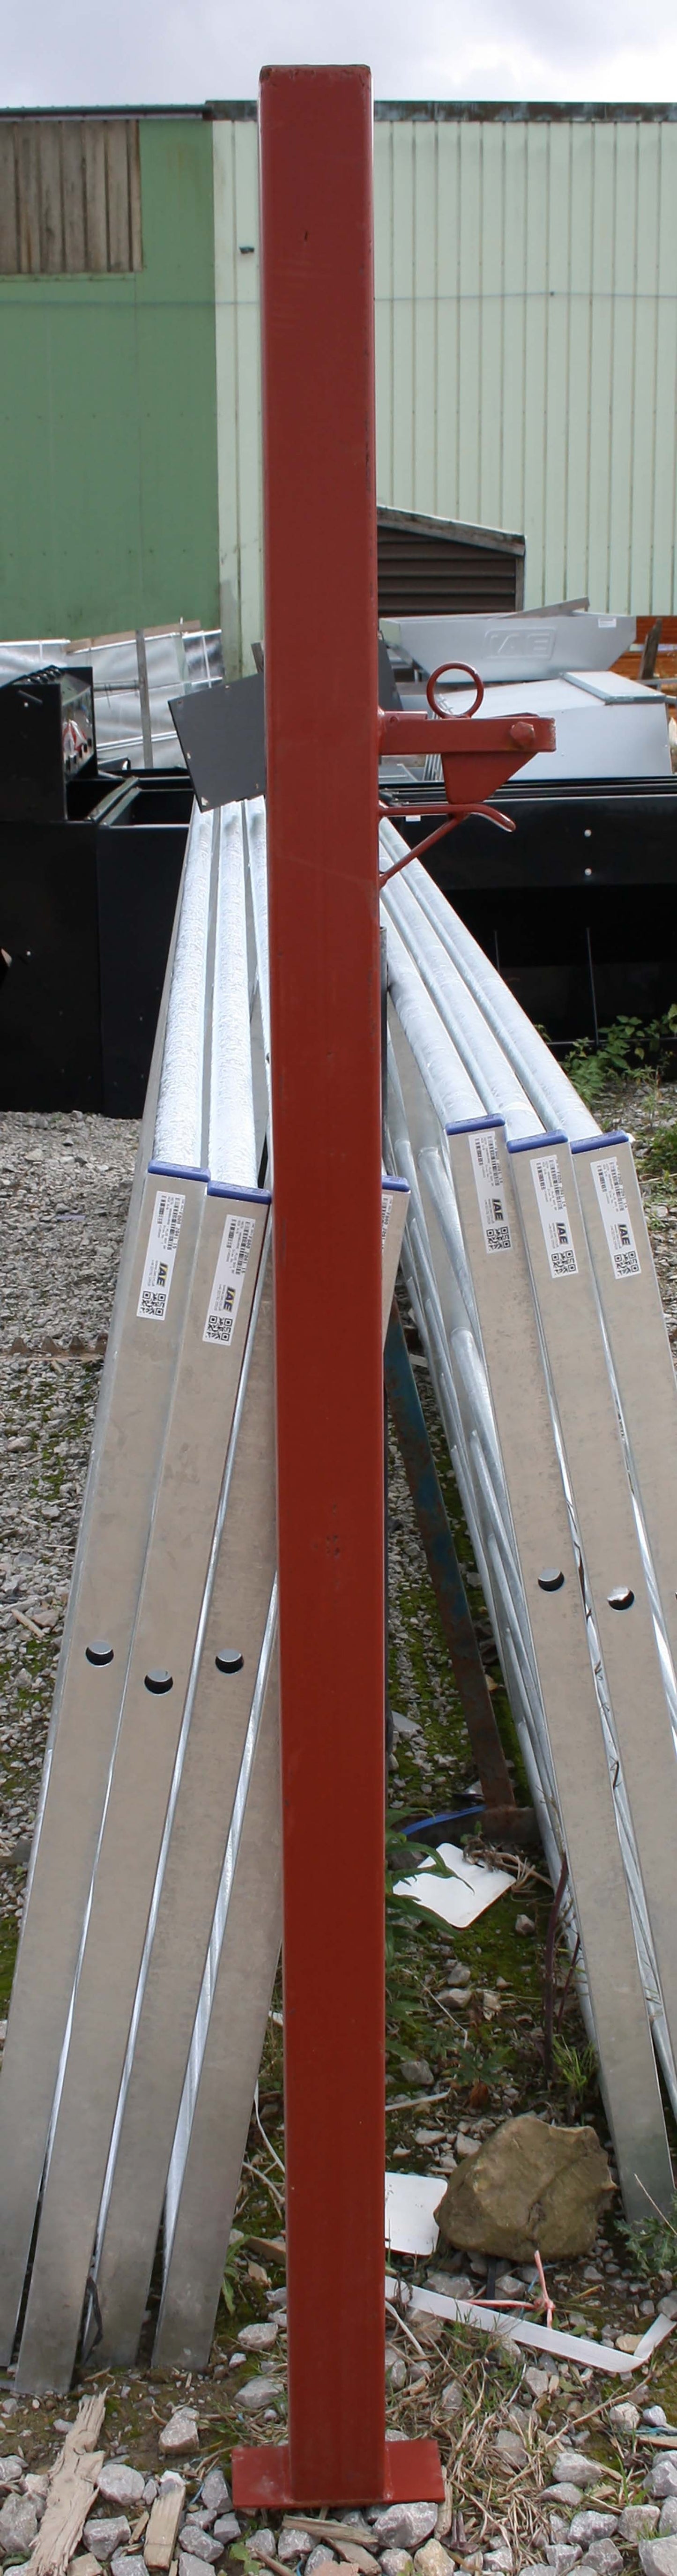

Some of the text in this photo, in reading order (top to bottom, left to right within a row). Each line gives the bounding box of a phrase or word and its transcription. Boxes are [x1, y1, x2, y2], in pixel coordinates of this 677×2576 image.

[492, 1198, 504, 1221] IAE
[557, 1223, 568, 1244] IAE
[618, 1224, 630, 1245] IAE
[156, 1263, 168, 1287] IAE
[223, 1287, 235, 1312] IAE
